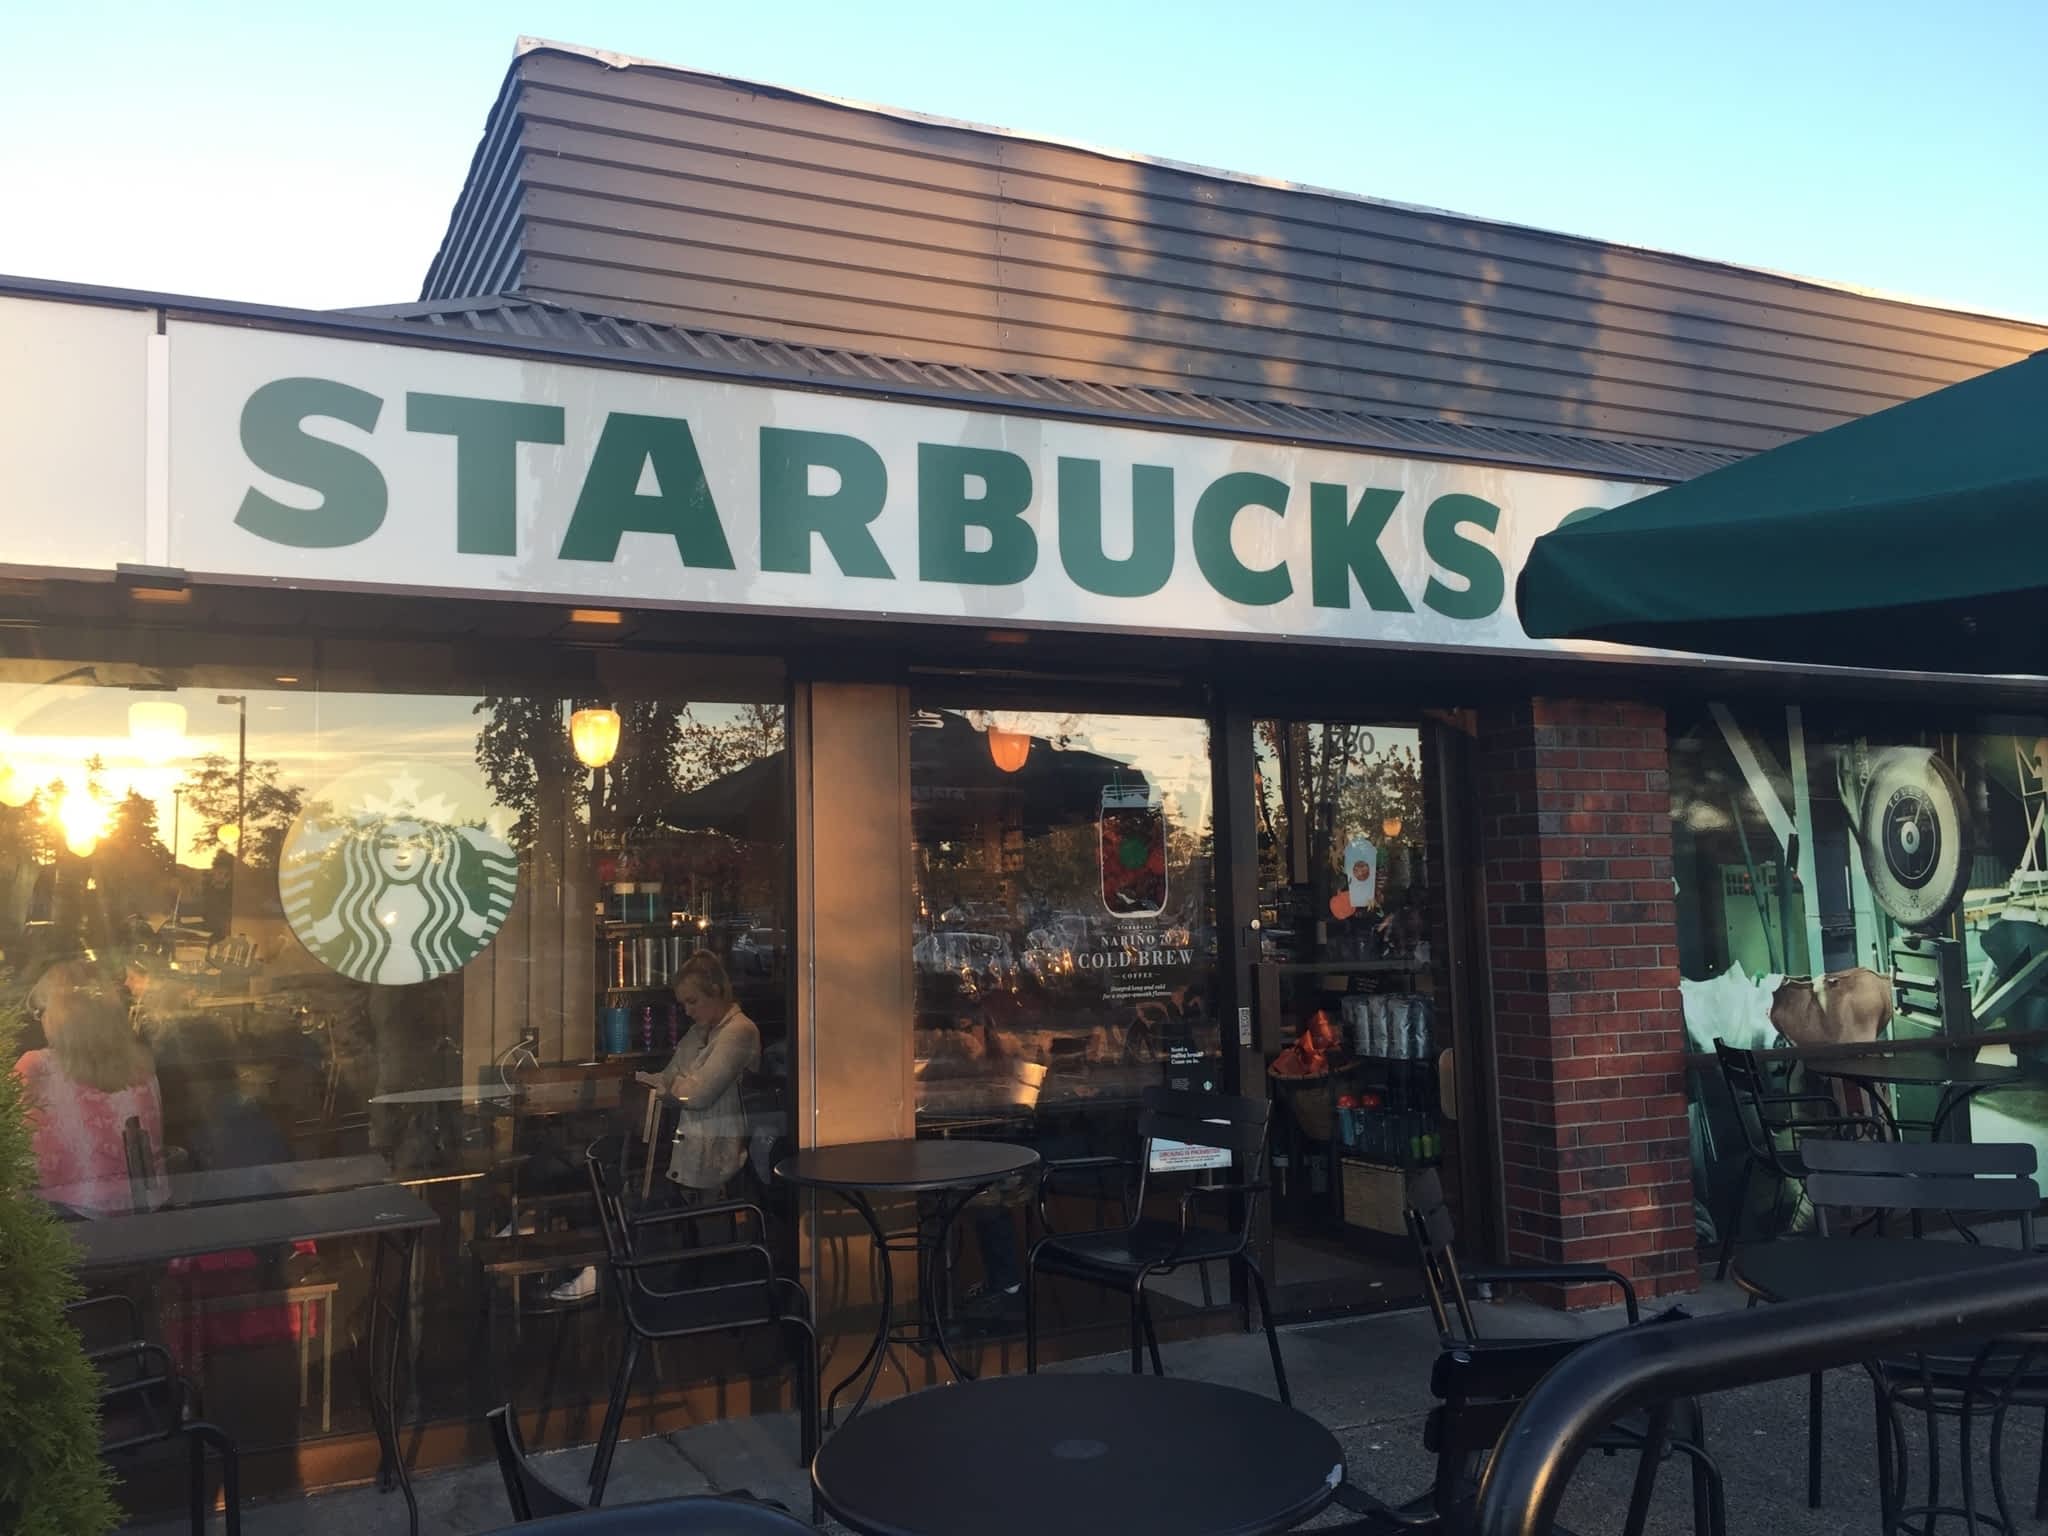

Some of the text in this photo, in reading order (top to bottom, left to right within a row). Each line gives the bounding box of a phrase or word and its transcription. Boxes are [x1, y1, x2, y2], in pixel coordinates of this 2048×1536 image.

[235, 377, 1506, 621] STARBUCKS
[1078, 950, 1194, 969] COLD BREW
[1122, 972, 1153, 980] COFFEE
